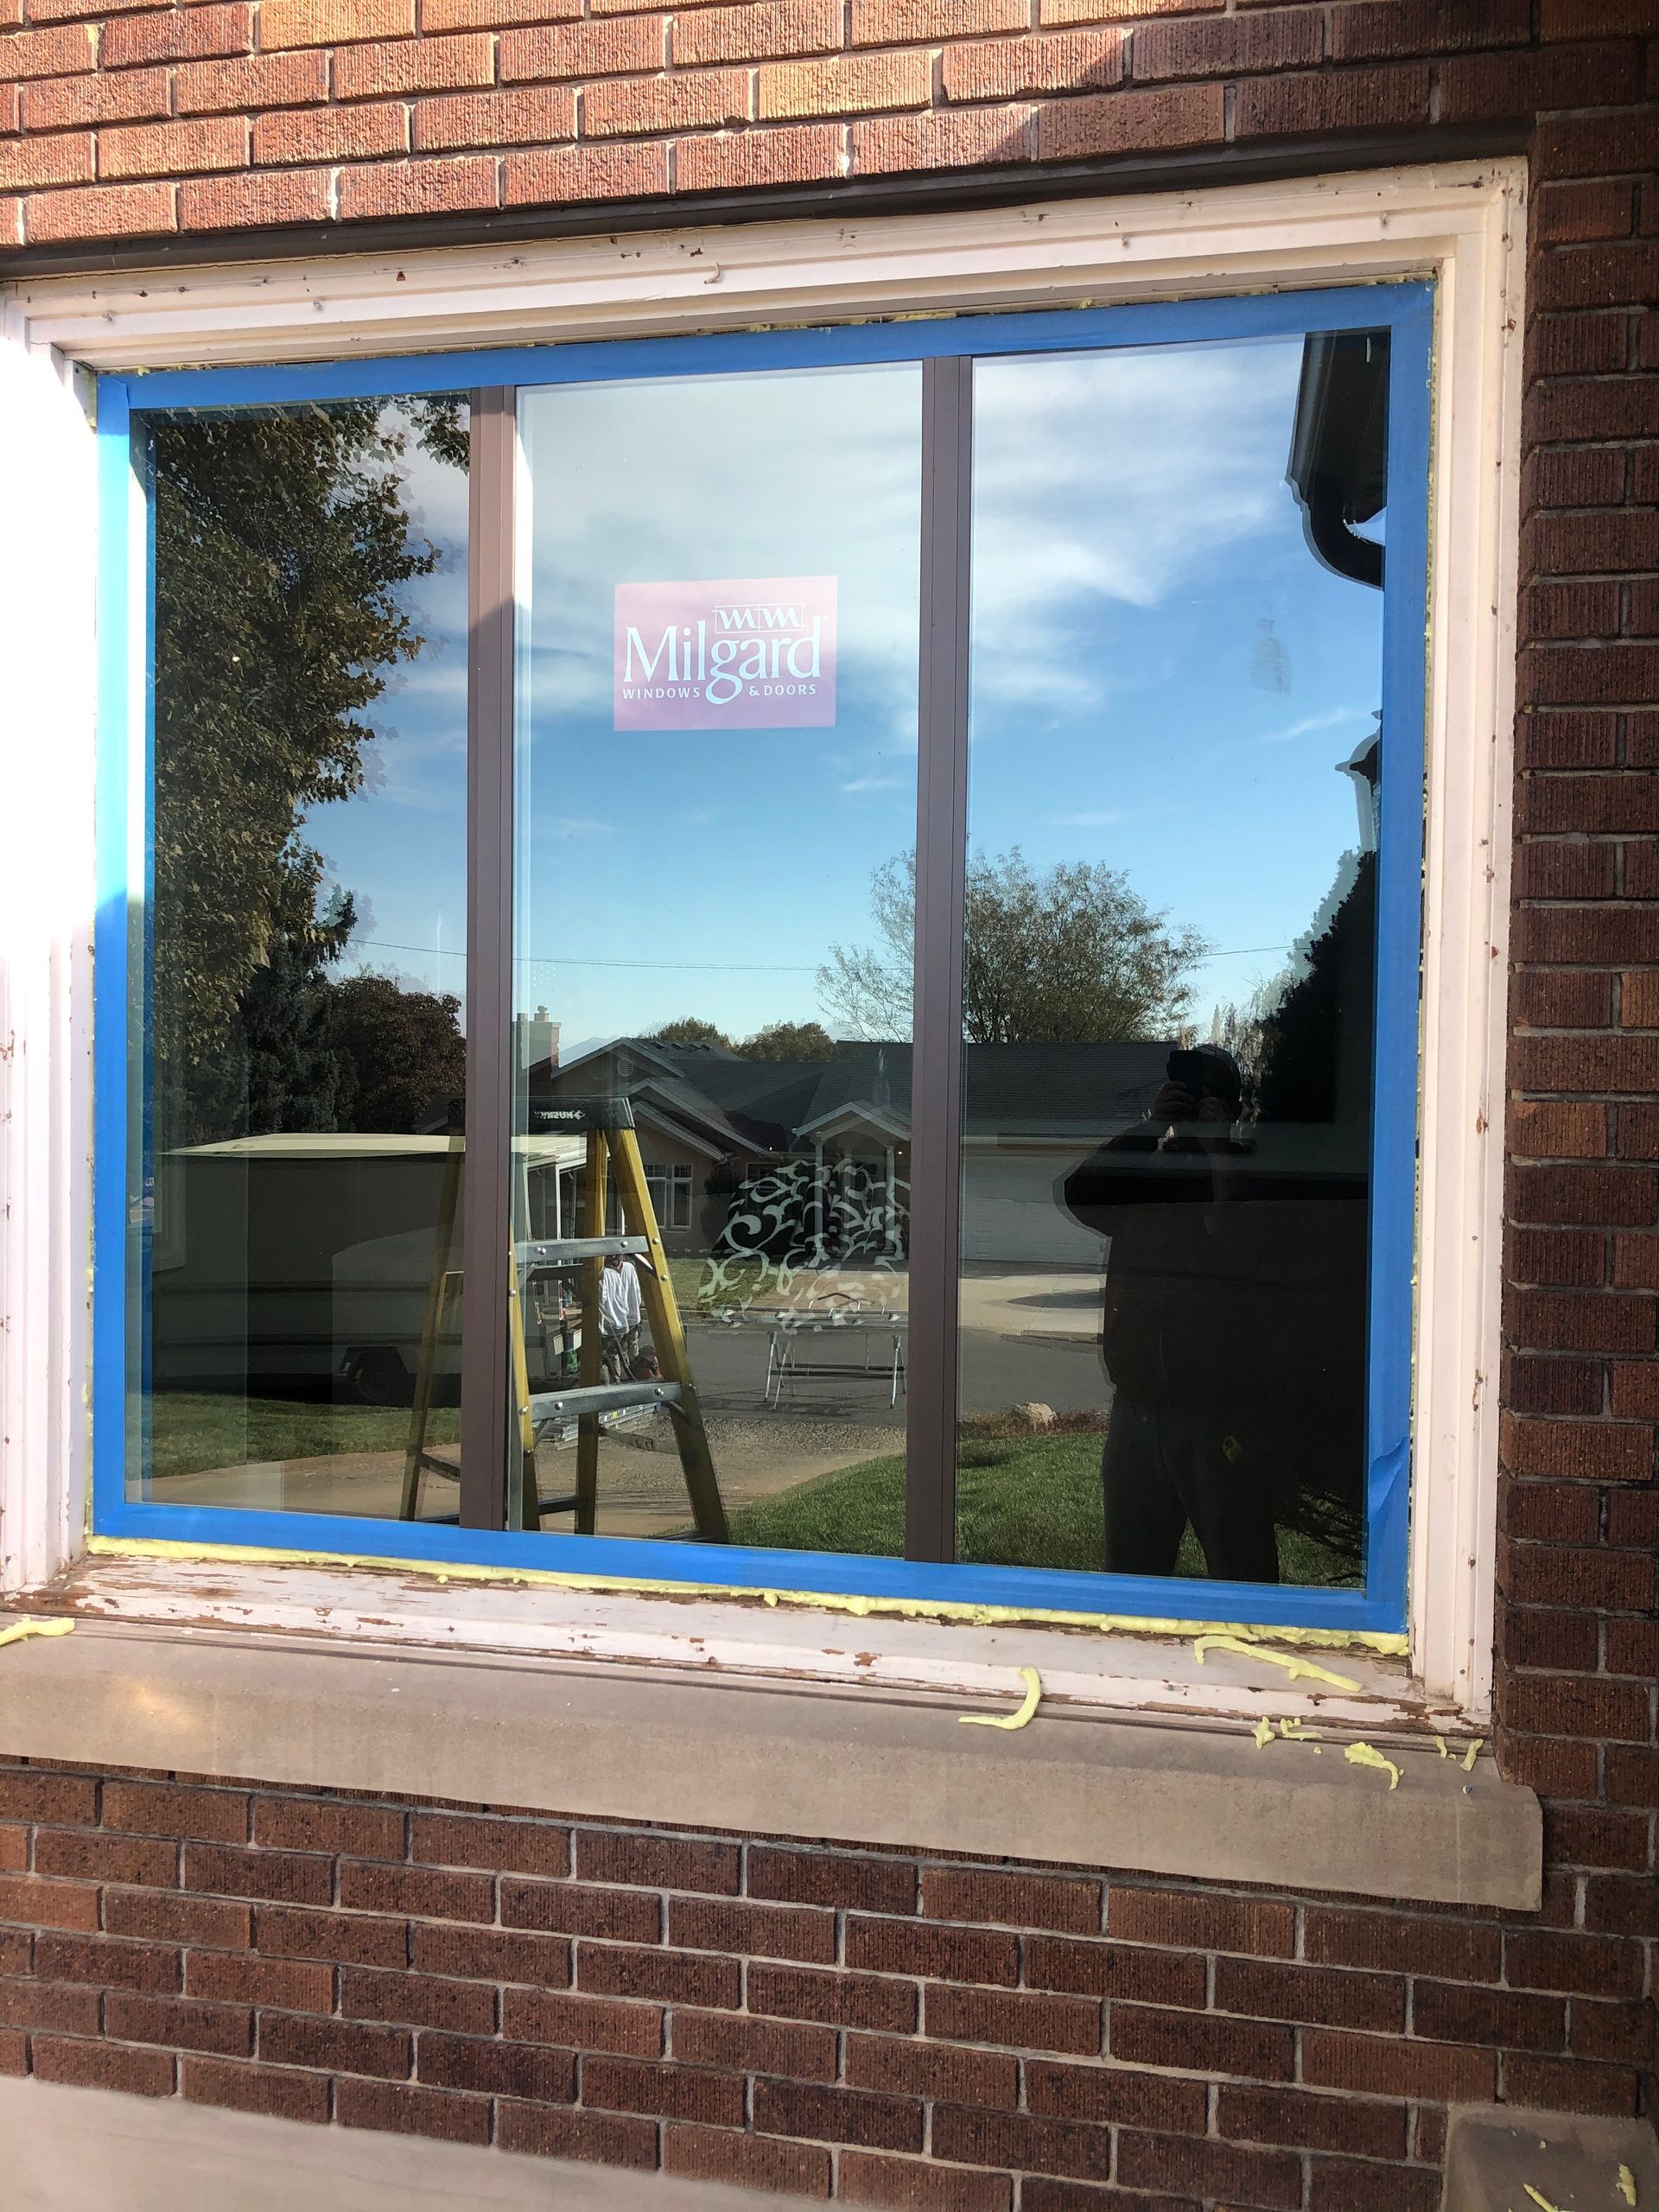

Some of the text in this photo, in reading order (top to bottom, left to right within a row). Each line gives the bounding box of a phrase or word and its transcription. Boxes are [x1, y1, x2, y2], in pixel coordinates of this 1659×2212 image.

[623, 615, 821, 704] Milgard
[622, 683, 817, 699] WINDOWS & DOORS
